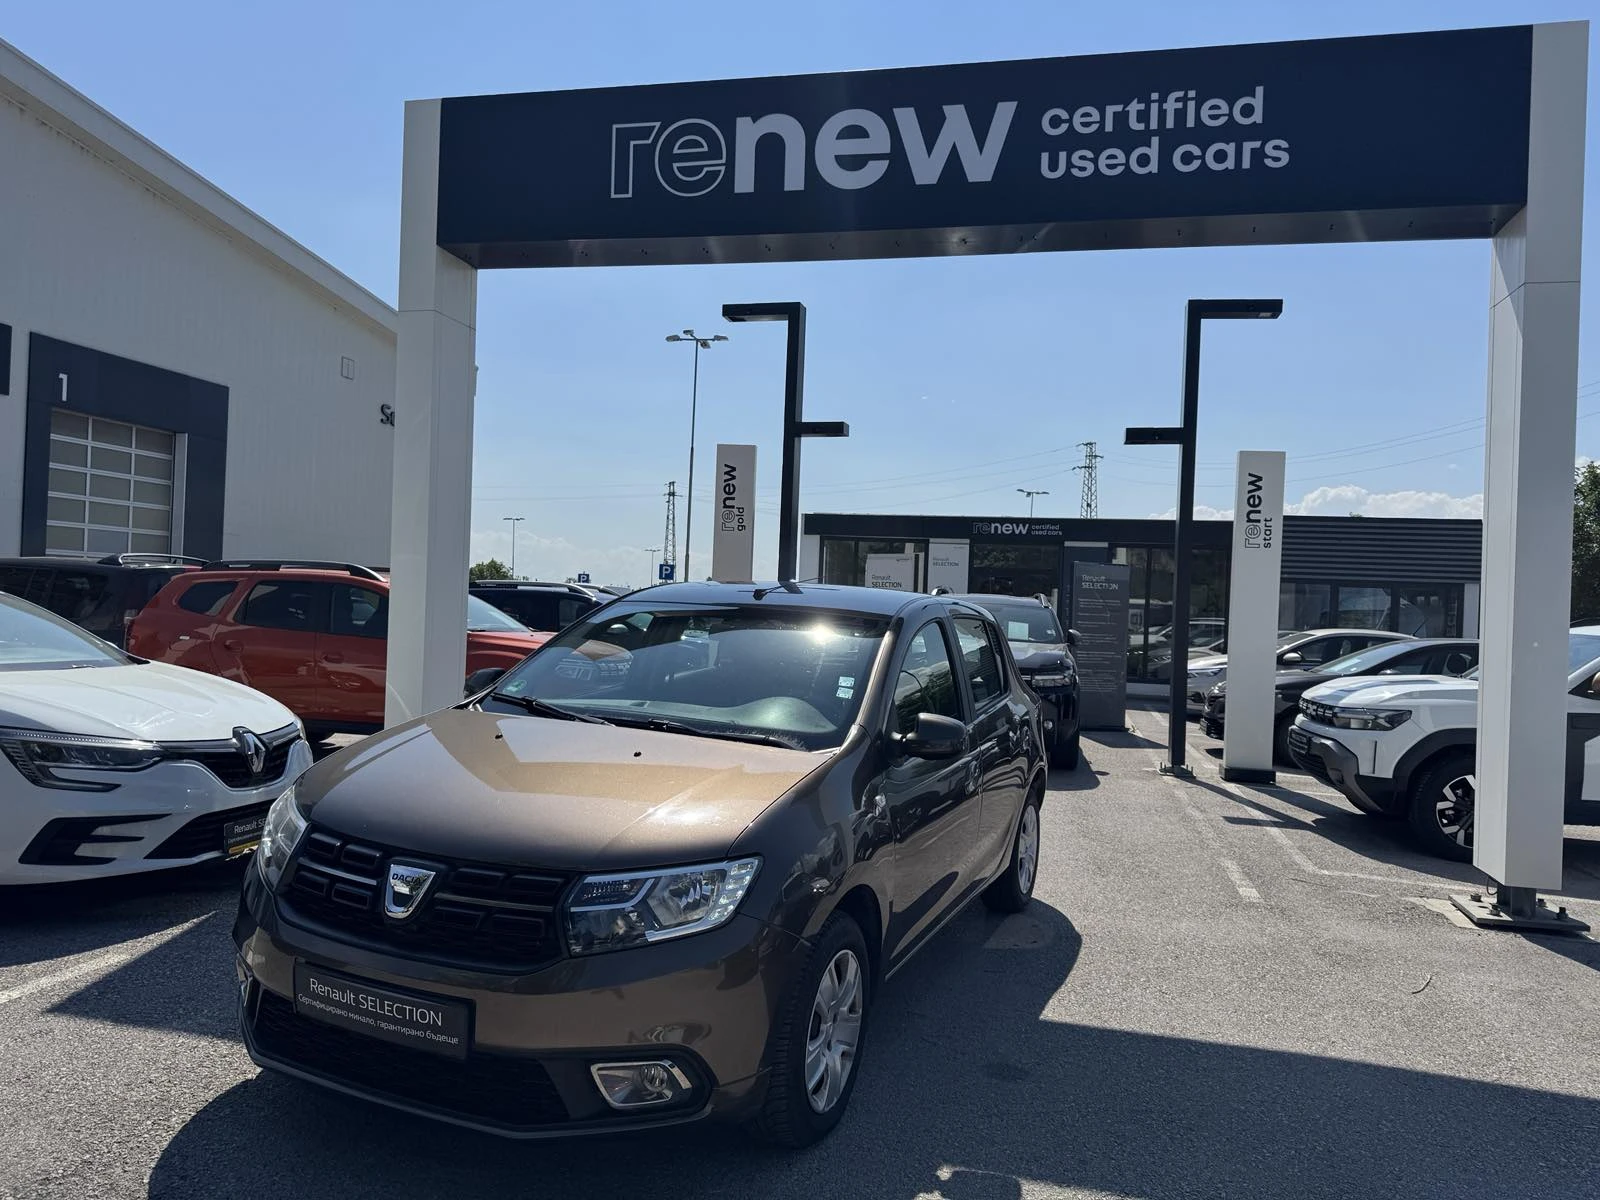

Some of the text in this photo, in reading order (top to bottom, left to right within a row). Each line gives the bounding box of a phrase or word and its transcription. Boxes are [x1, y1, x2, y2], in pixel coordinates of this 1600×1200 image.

[1040, 86, 1265, 136] certified
[609, 101, 1018, 199] renew
[1040, 137, 1290, 180] used cars
[58, 373, 68, 402] 1
[721, 463, 737, 532] renew
[1244, 472, 1263, 549] renew
[736, 506, 746, 532] gold
[972, 522, 1029, 535] renew
[1263, 517, 1273, 549] start
[662, 565, 671, 578] P
[1081, 582, 1119, 590] SELECTION
[234, 819, 258, 834] Renault
[391, 873, 421, 884] DACIA
[309, 978, 442, 1026] Renault SELECTION
[297, 993, 459, 1046] Сертифицирано минало, гарантирано бъдеще
